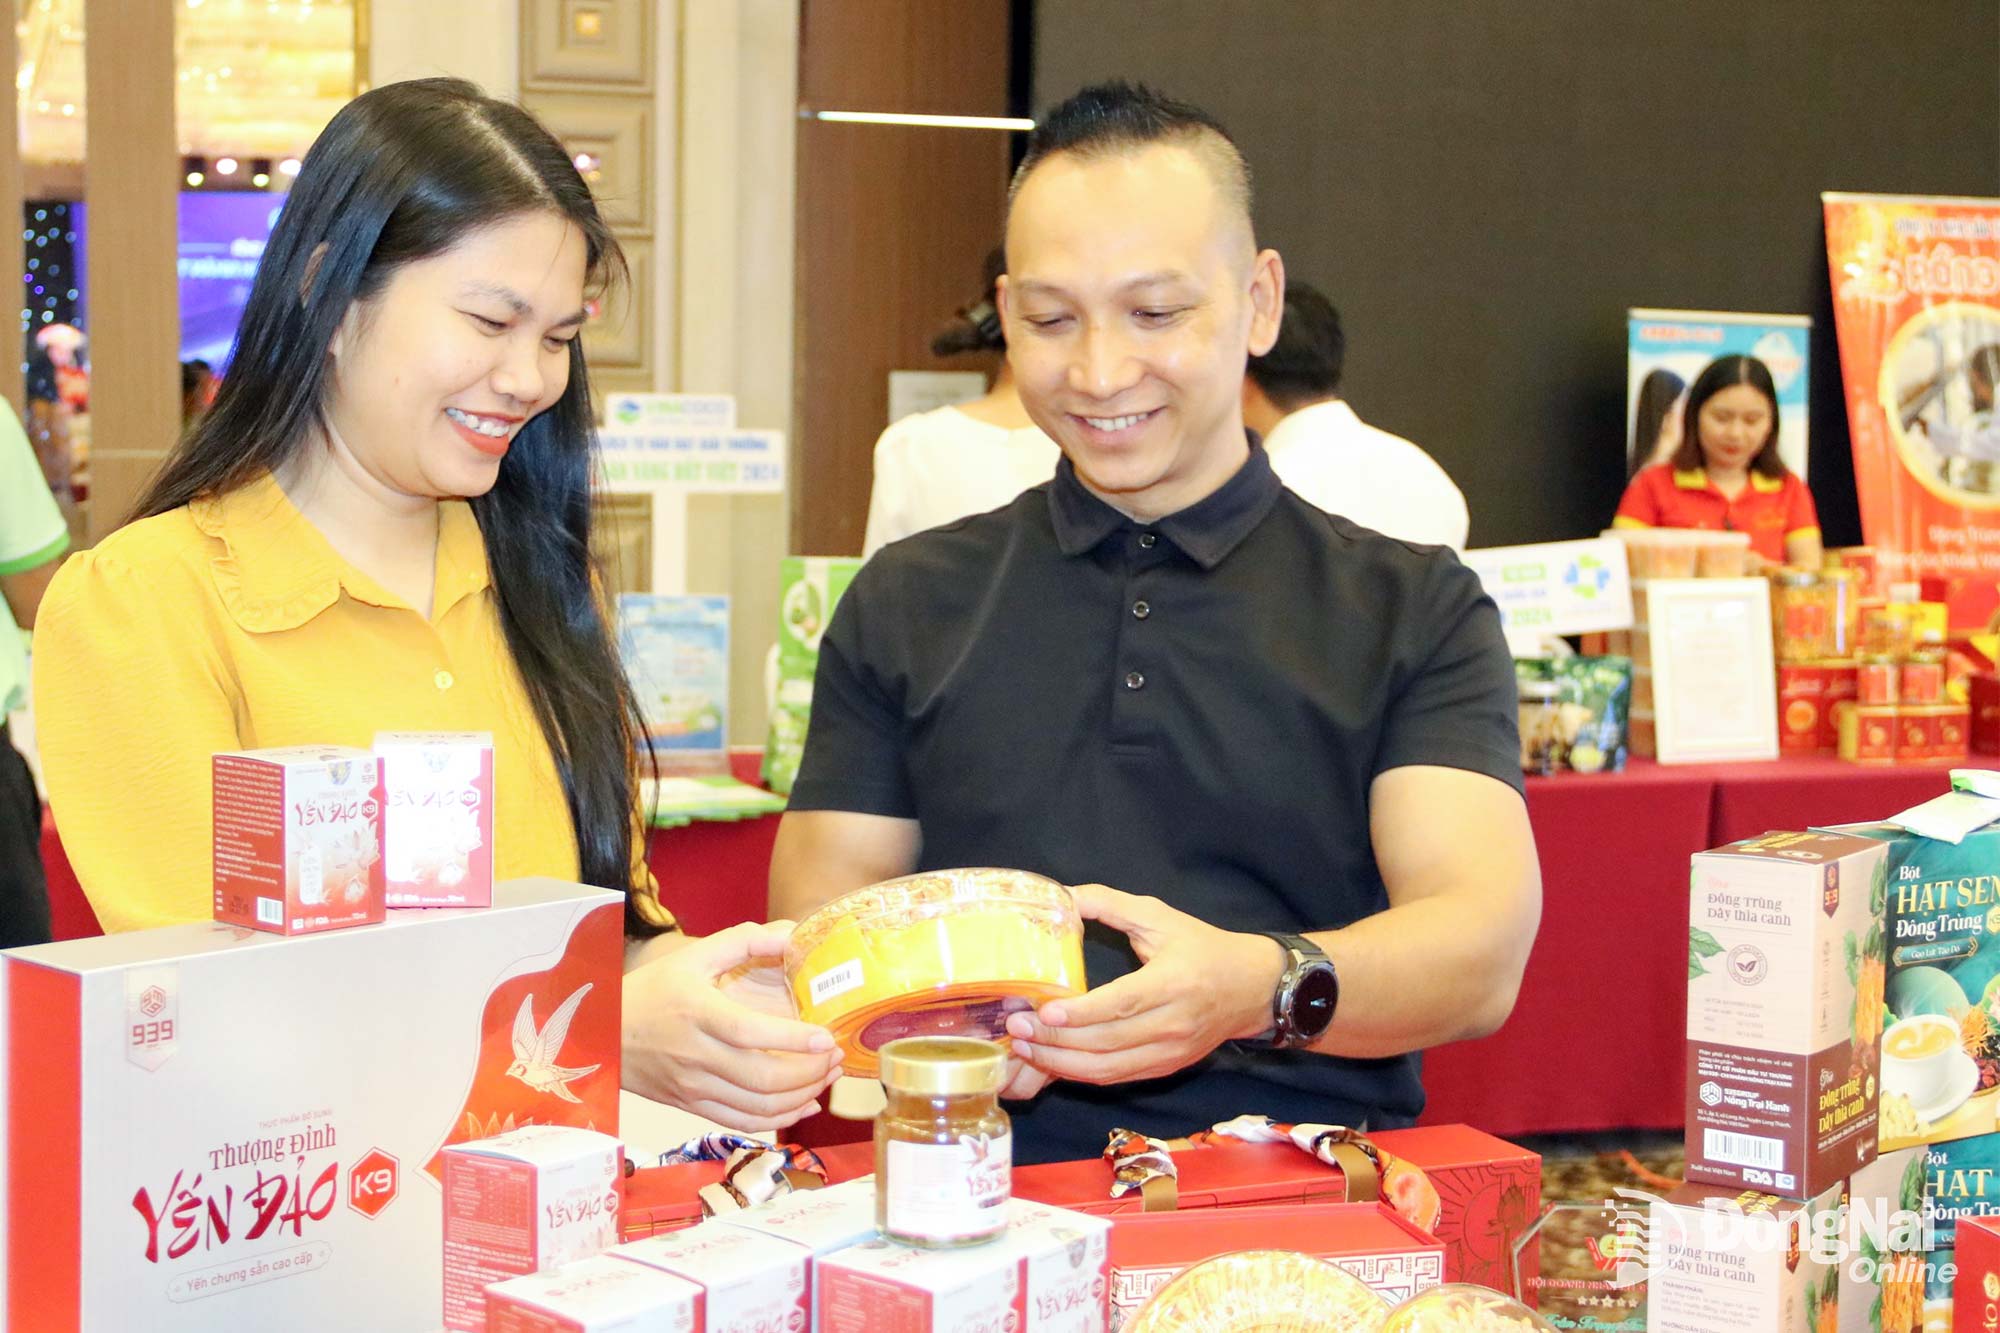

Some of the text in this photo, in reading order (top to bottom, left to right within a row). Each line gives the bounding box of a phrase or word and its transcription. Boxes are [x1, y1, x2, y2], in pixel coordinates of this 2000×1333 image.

[1899, 865, 1921, 882] Bột
[1896, 880, 1953, 917] HẠT
[1761, 912, 1792, 927] canh
[1896, 918, 1936, 942] Đông
[1937, 913, 1984, 935] Trùng
[132, 1019, 174, 1046] 939
[209, 1123, 336, 1171] Thượng Đỉnh
[1742, 1167, 1773, 1186] FDA
[132, 1155, 392, 1263] YẾN ĐẢO K9
[187, 1275, 208, 1292] Yến
[210, 1266, 247, 1287] chưng
[272, 1258, 291, 1271] cao
[294, 1250, 313, 1268] cấp
